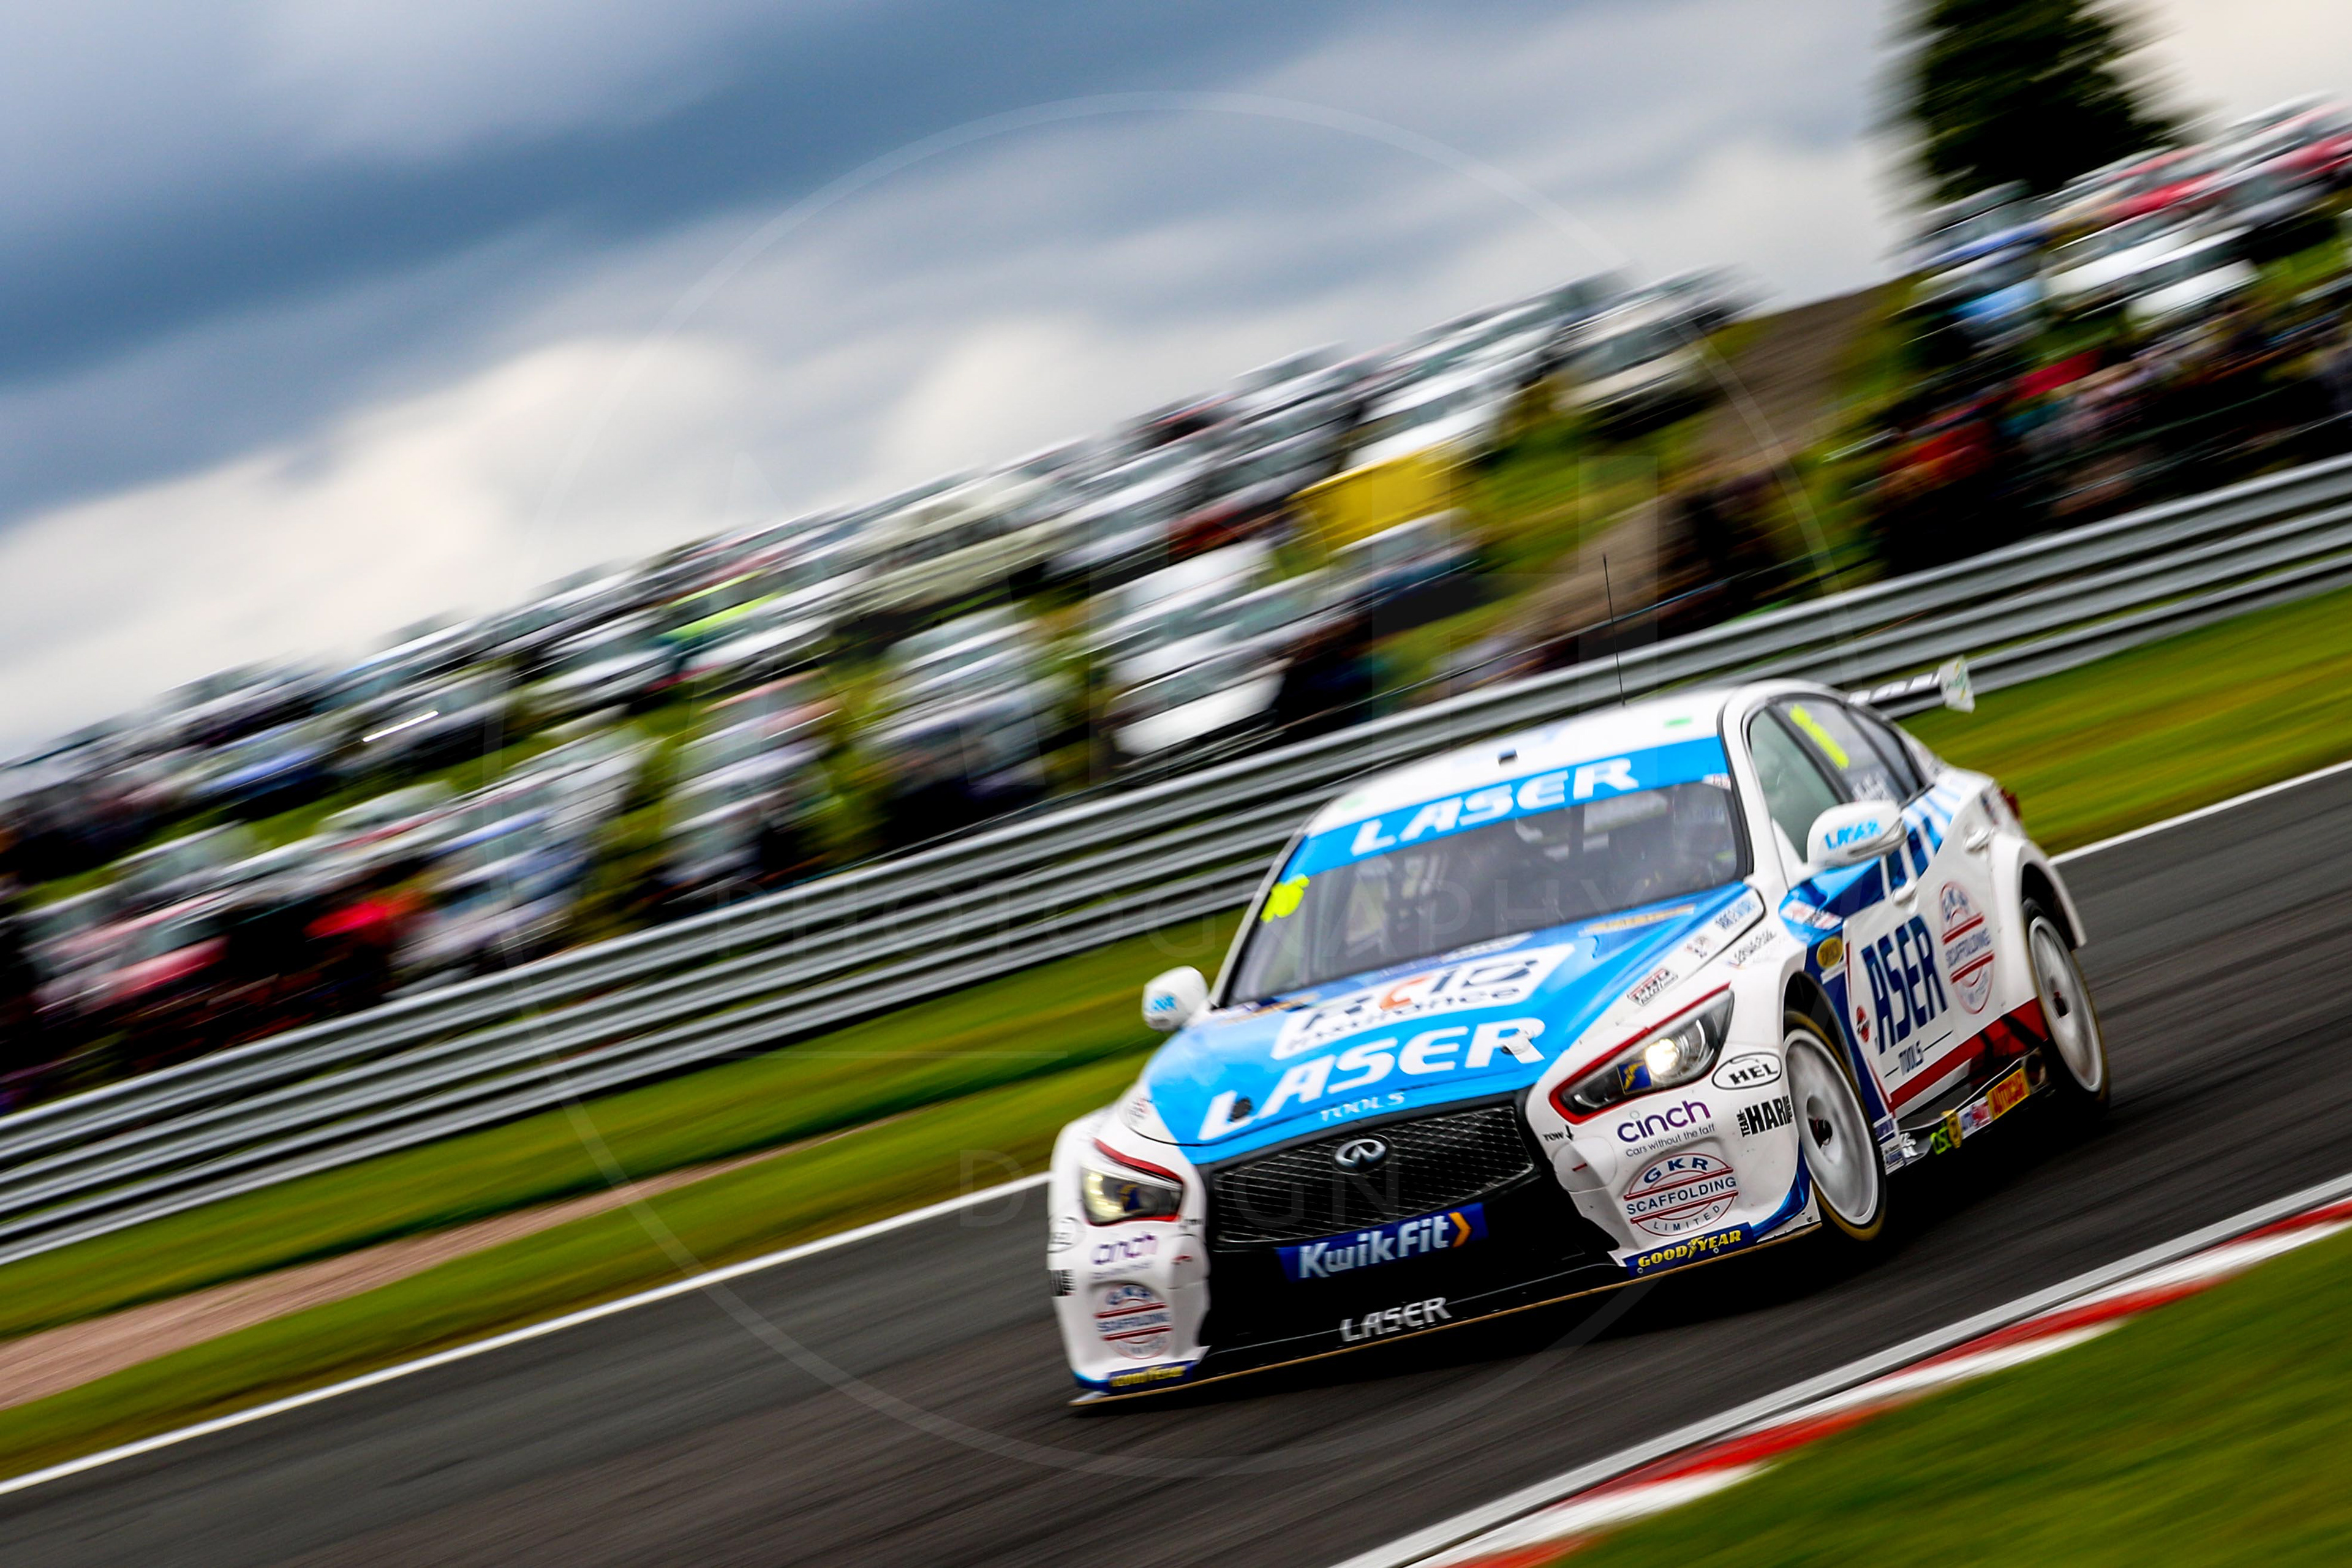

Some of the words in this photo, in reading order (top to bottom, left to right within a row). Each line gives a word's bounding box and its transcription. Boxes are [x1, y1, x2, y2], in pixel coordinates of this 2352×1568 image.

[1349, 757, 1639, 856] LASER
[1197, 1017, 1547, 1141] LASER
[1728, 1063, 1778, 1085] HEL
[1321, 1091, 1405, 1121] TOOLS
[1616, 1101, 1711, 1143] cinch
[1626, 1145, 1647, 1158] Cars
[1648, 1133, 1682, 1152] without
[1683, 1129, 1698, 1142] the
[1698, 1122, 1716, 1140] faff
[1644, 1157, 1709, 1185] GKR
[1626, 1176, 1736, 1215] SCAFFOLDING
[1653, 1204, 1721, 1231] LIMITED
[1339, 1297, 1452, 1342] LASER
